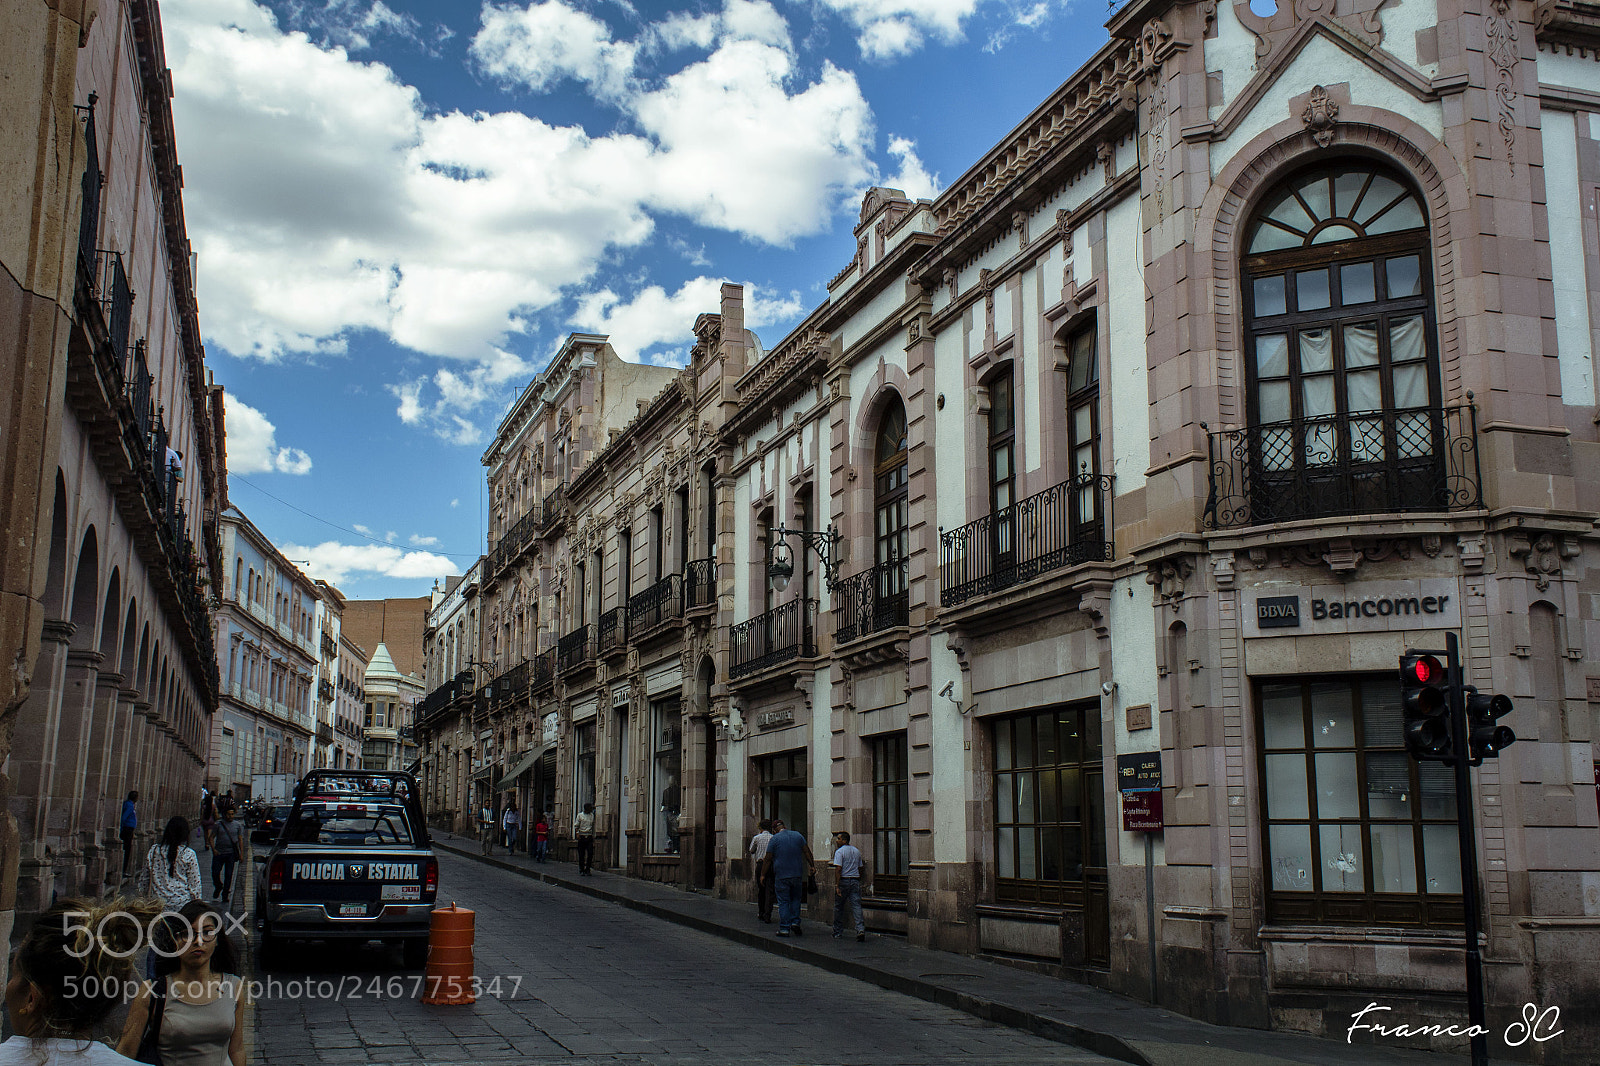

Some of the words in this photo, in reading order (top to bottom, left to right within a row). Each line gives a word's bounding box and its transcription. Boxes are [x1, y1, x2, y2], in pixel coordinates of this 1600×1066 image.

[1258, 604, 1297, 619] BBVA
[1311, 595, 1450, 620] Bancomer
[1123, 768, 1135, 776] RED
[292, 863, 345, 880] POLICIA
[367, 863, 420, 880] ESTATAL
